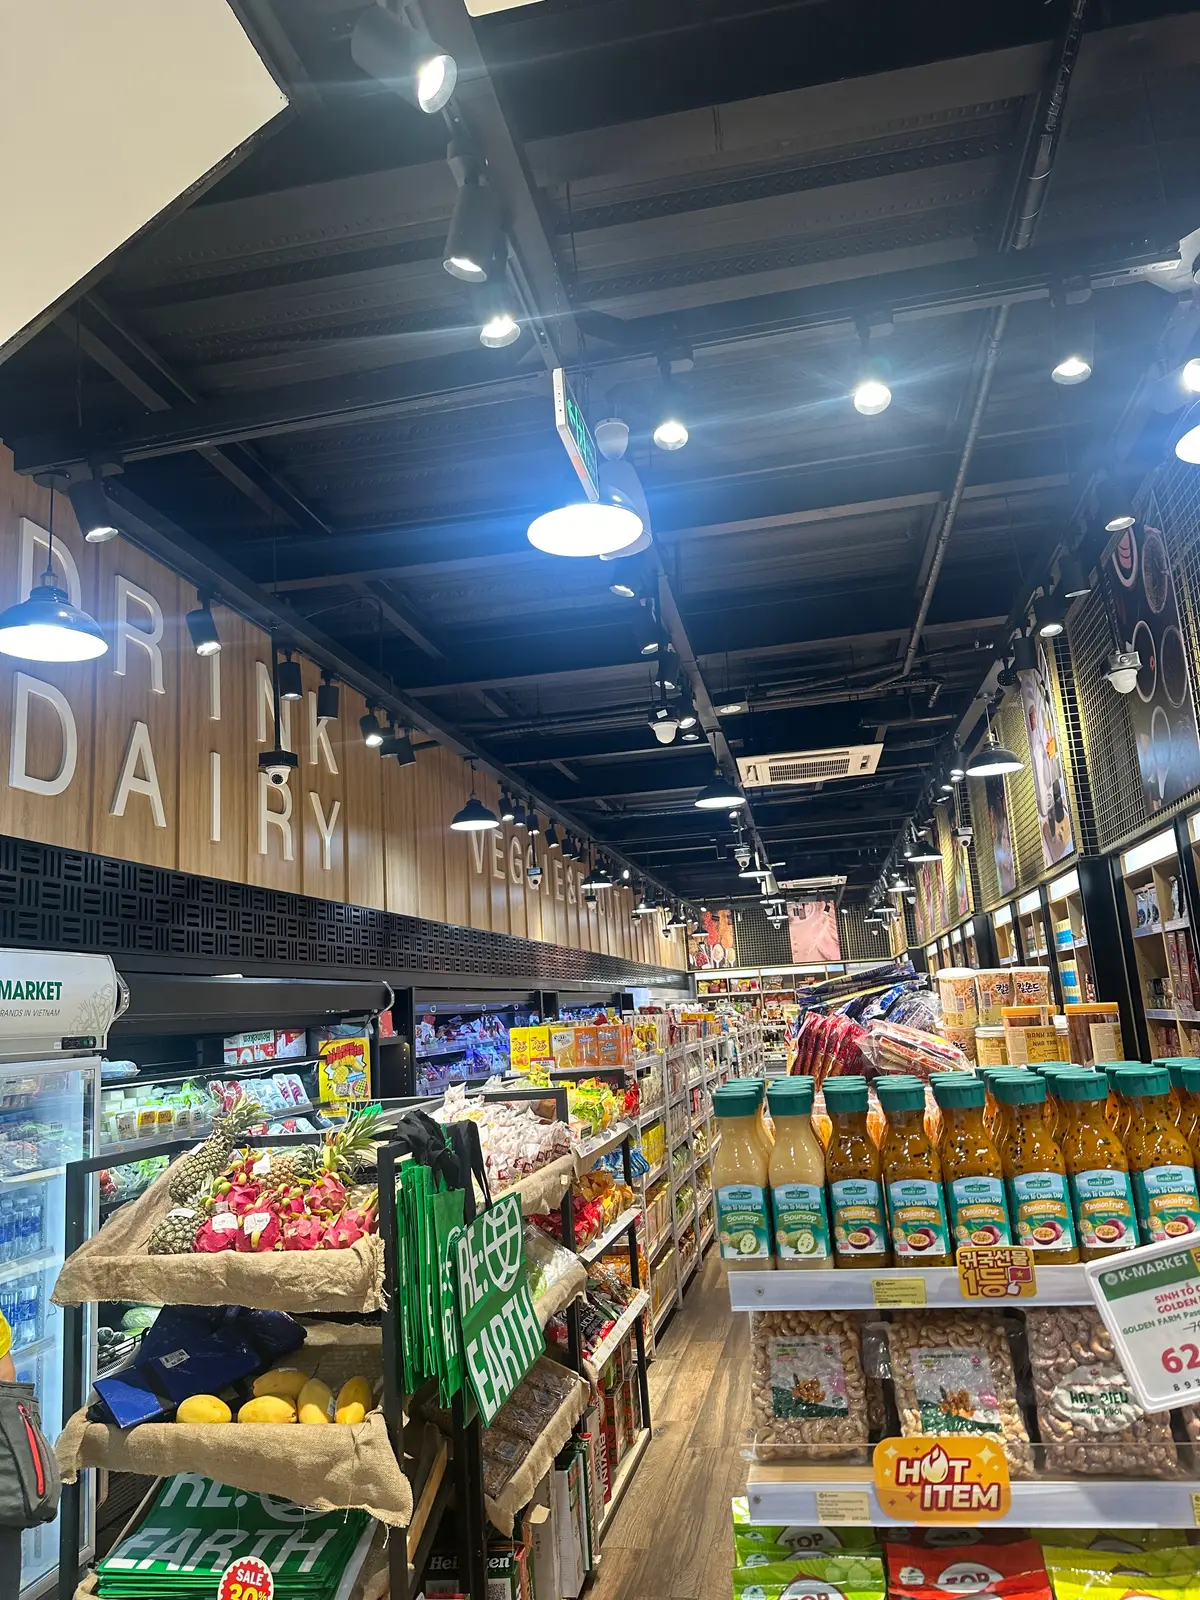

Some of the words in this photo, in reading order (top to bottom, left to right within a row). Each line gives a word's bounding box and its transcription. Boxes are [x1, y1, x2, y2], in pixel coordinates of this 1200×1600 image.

[20, 517, 338, 775] DRINK
[9, 671, 341, 870] DAIRY
[24, 1009, 31, 1017] IN
[33, 1009, 60, 1017] VIETNAM
[1047, 1203, 1061, 1211] Fruit
[1109, 1200, 1124, 1209] Fruit
[1177, 1196, 1193, 1205] Fruit
[727, 1215, 759, 1223] Soursop
[784, 1214, 817, 1223] Soursop
[862, 1209, 876, 1217] Fruit
[921, 1210, 935, 1218] Fruit
[985, 1207, 999, 1216] Fruit
[961, 1250, 1028, 1268] 귀국선물
[1118, 1253, 1189, 1282] K-MARKET
[963, 1268, 1009, 1297] 1등
[1154, 1290, 1180, 1304] SINH
[1180, 1282, 1194, 1296] TỐ
[1158, 1297, 1198, 1313] GOLDEN
[1123, 1319, 1155, 1335] GOLDEN
[1158, 1313, 1182, 1326] FARM
[466, 1285, 543, 1422] EARTH
[1161, 1343, 1200, 1373] 62
[898, 1446, 970, 1484] HOT
[922, 1485, 999, 1509] ITEM
[785, 1533, 824, 1548] TOP
[104, 1528, 338, 1572] EARTH
[236, 1568, 264, 1587] SALE
[229, 1583, 267, 1600] 30%
